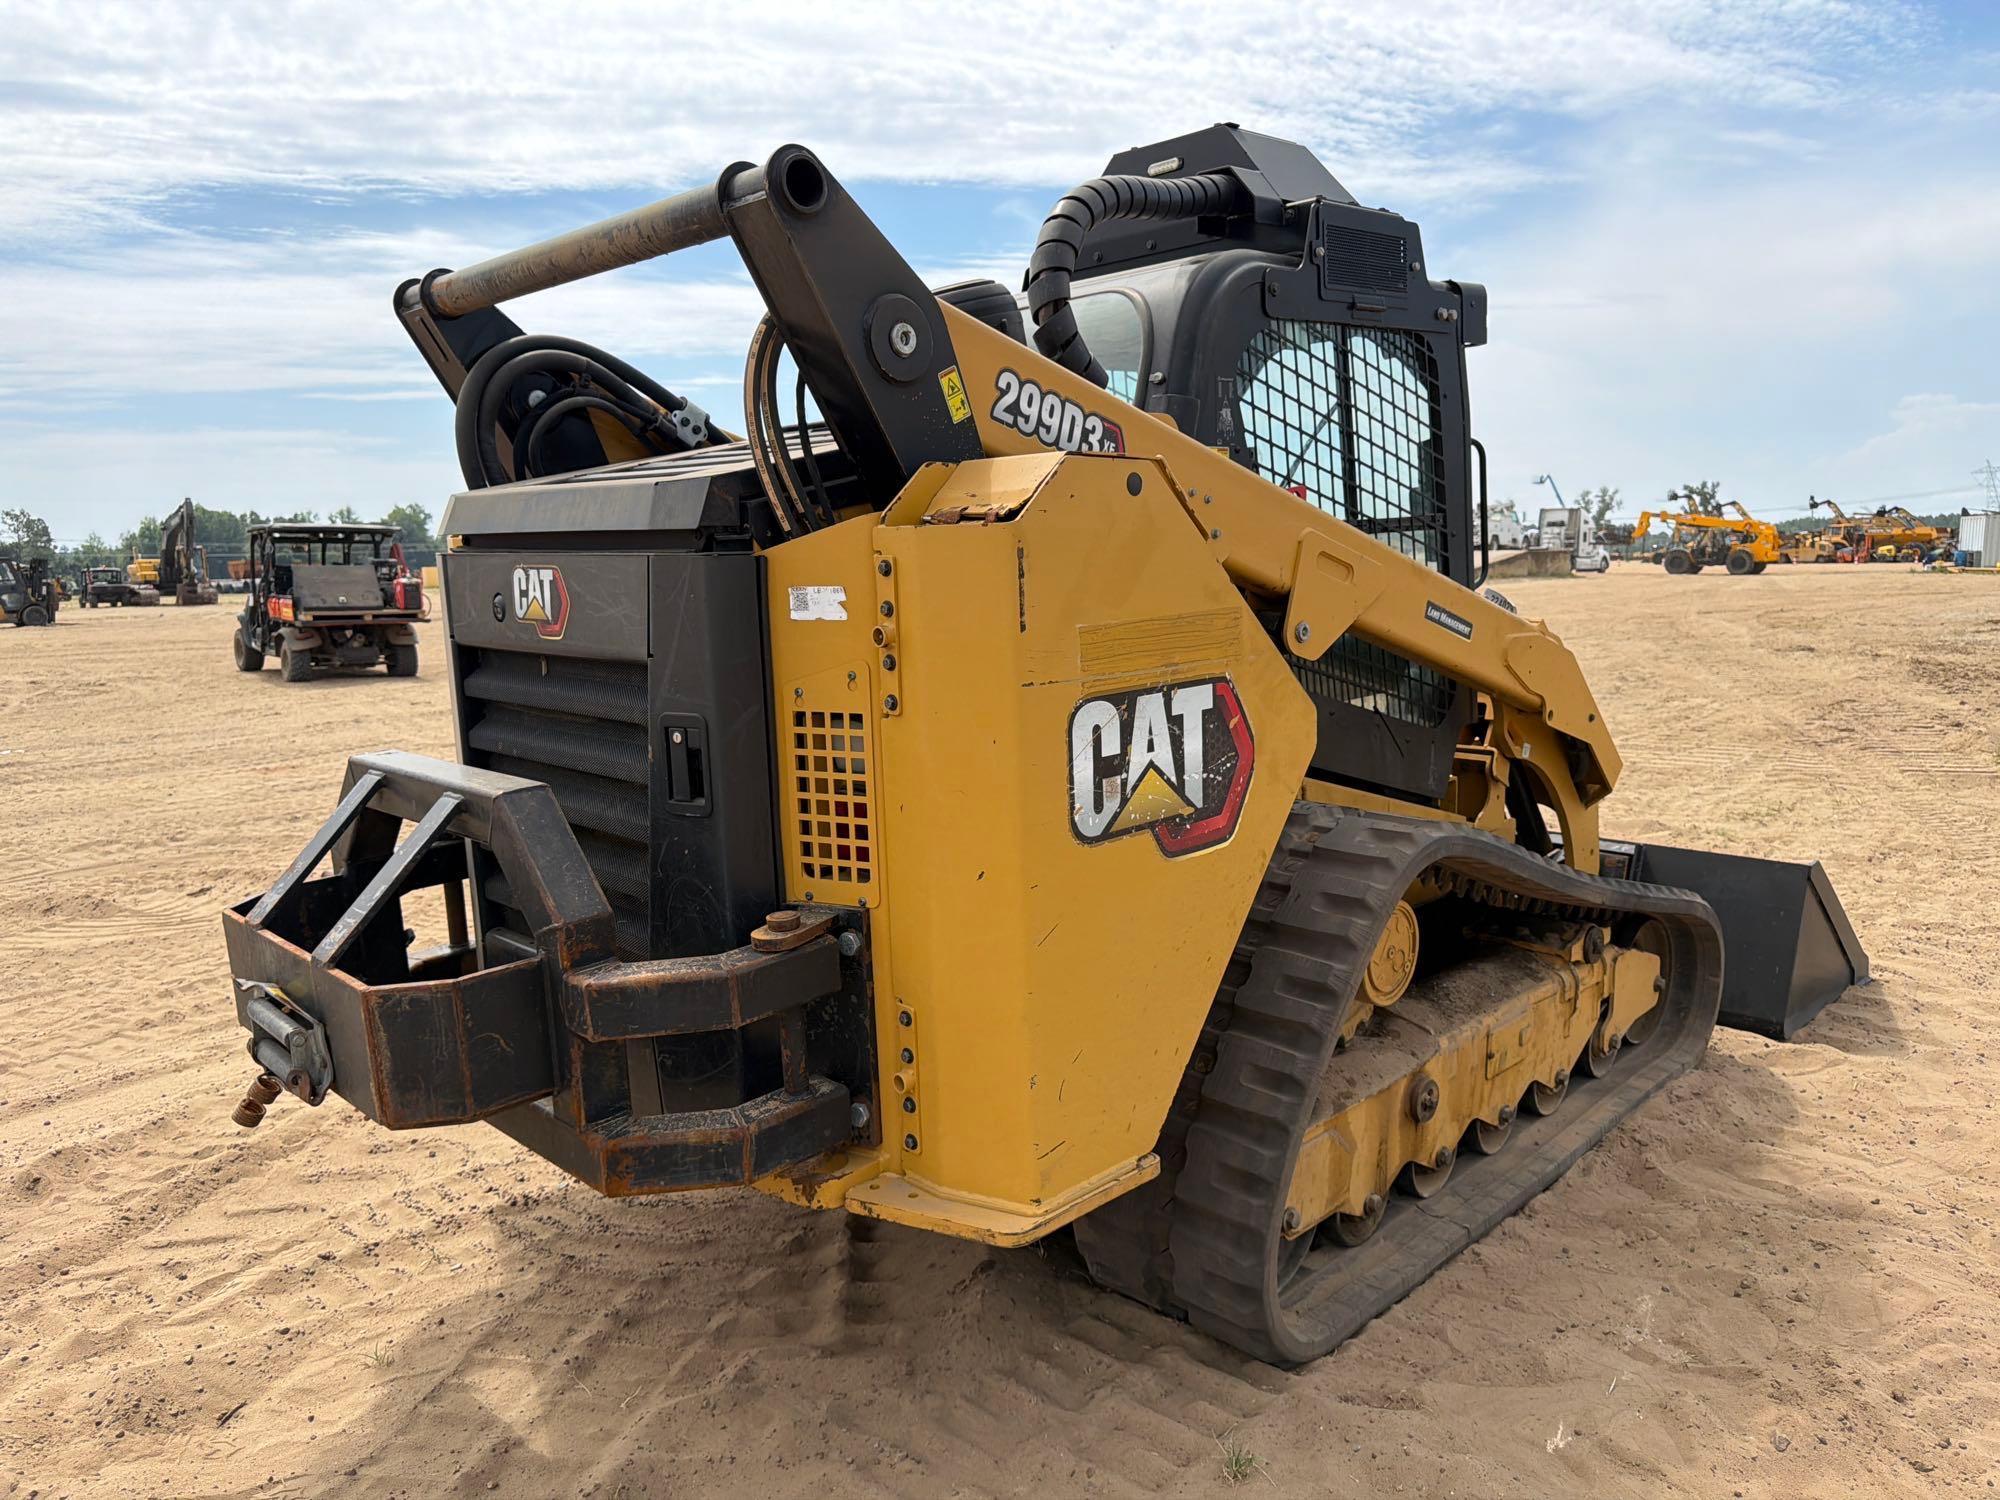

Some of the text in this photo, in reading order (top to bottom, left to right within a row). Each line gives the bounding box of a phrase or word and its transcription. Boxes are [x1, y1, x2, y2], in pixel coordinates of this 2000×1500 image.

[993, 371, 1104, 452] 299D3
[513, 568, 554, 622] CAT
[1427, 606, 1472, 636] LAND MANAGEMENT
[1072, 683, 1214, 837] CAT
